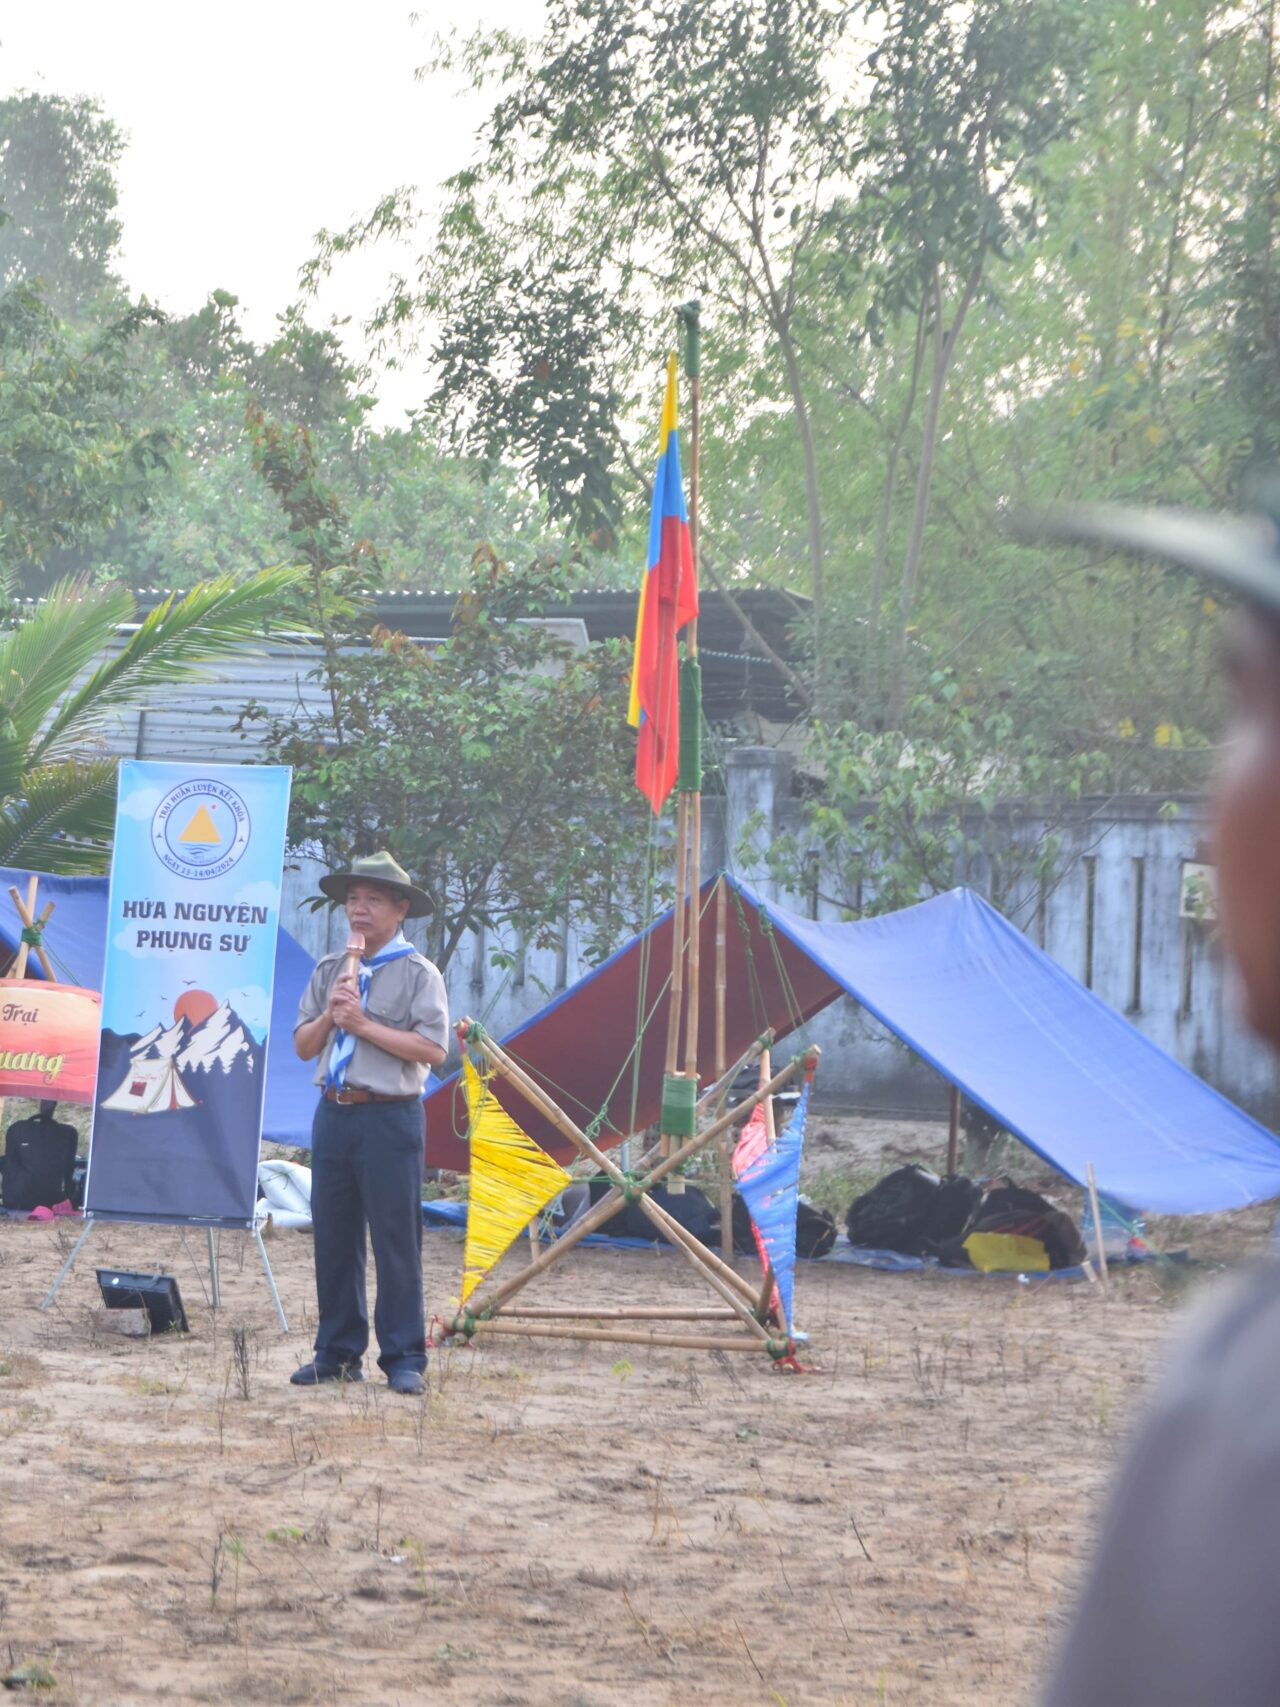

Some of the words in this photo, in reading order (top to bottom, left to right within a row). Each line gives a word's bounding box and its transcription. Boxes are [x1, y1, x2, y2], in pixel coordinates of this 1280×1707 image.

[122, 897, 167, 919] HỨA
[174, 901, 269, 927] NGUYỆN
[136, 930, 213, 953] PHỤNG
[219, 934, 252, 956] SỰ
[2, 1003, 39, 1026] Trại
